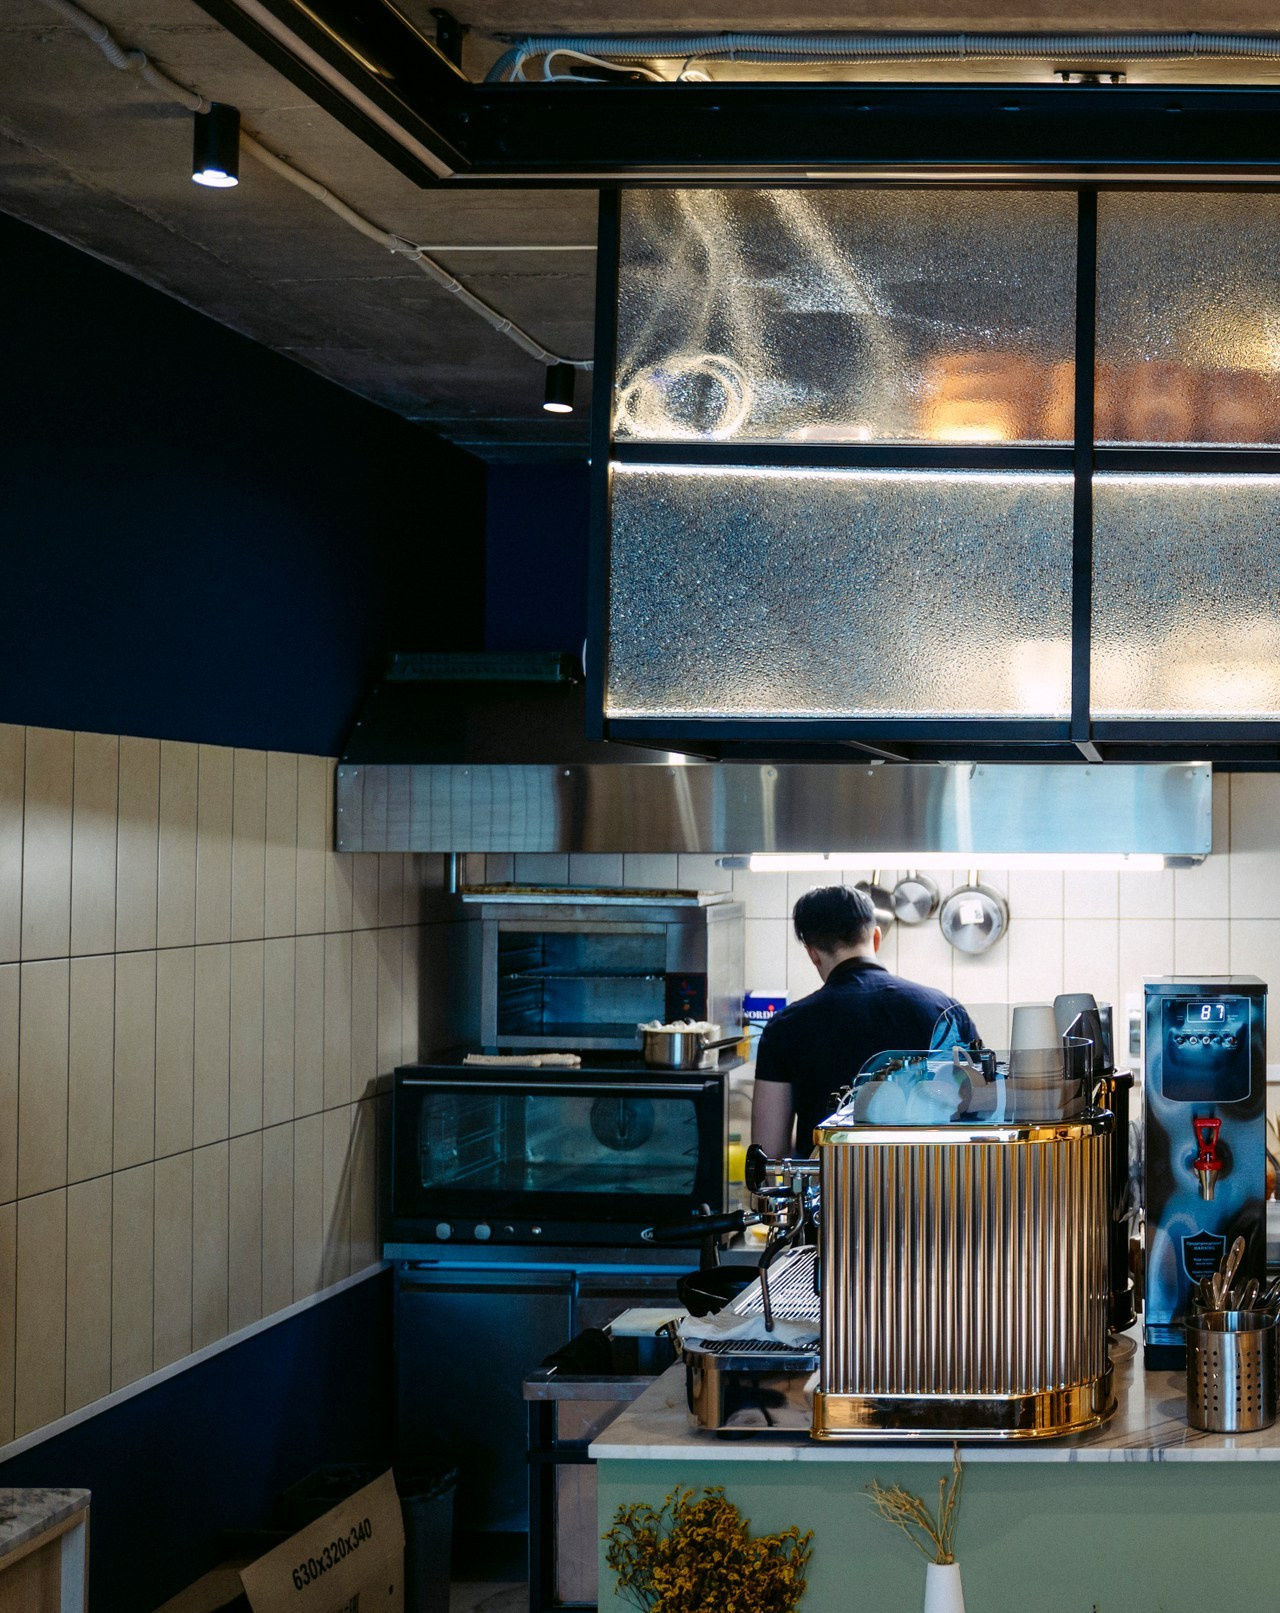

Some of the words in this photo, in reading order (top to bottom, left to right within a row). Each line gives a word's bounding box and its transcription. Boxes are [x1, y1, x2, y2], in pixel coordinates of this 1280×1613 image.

[743, 1010, 778, 1020] NORDI
[1200, 1004, 1225, 1020] 87
[292, 1518, 372, 1591] 630x320x340
